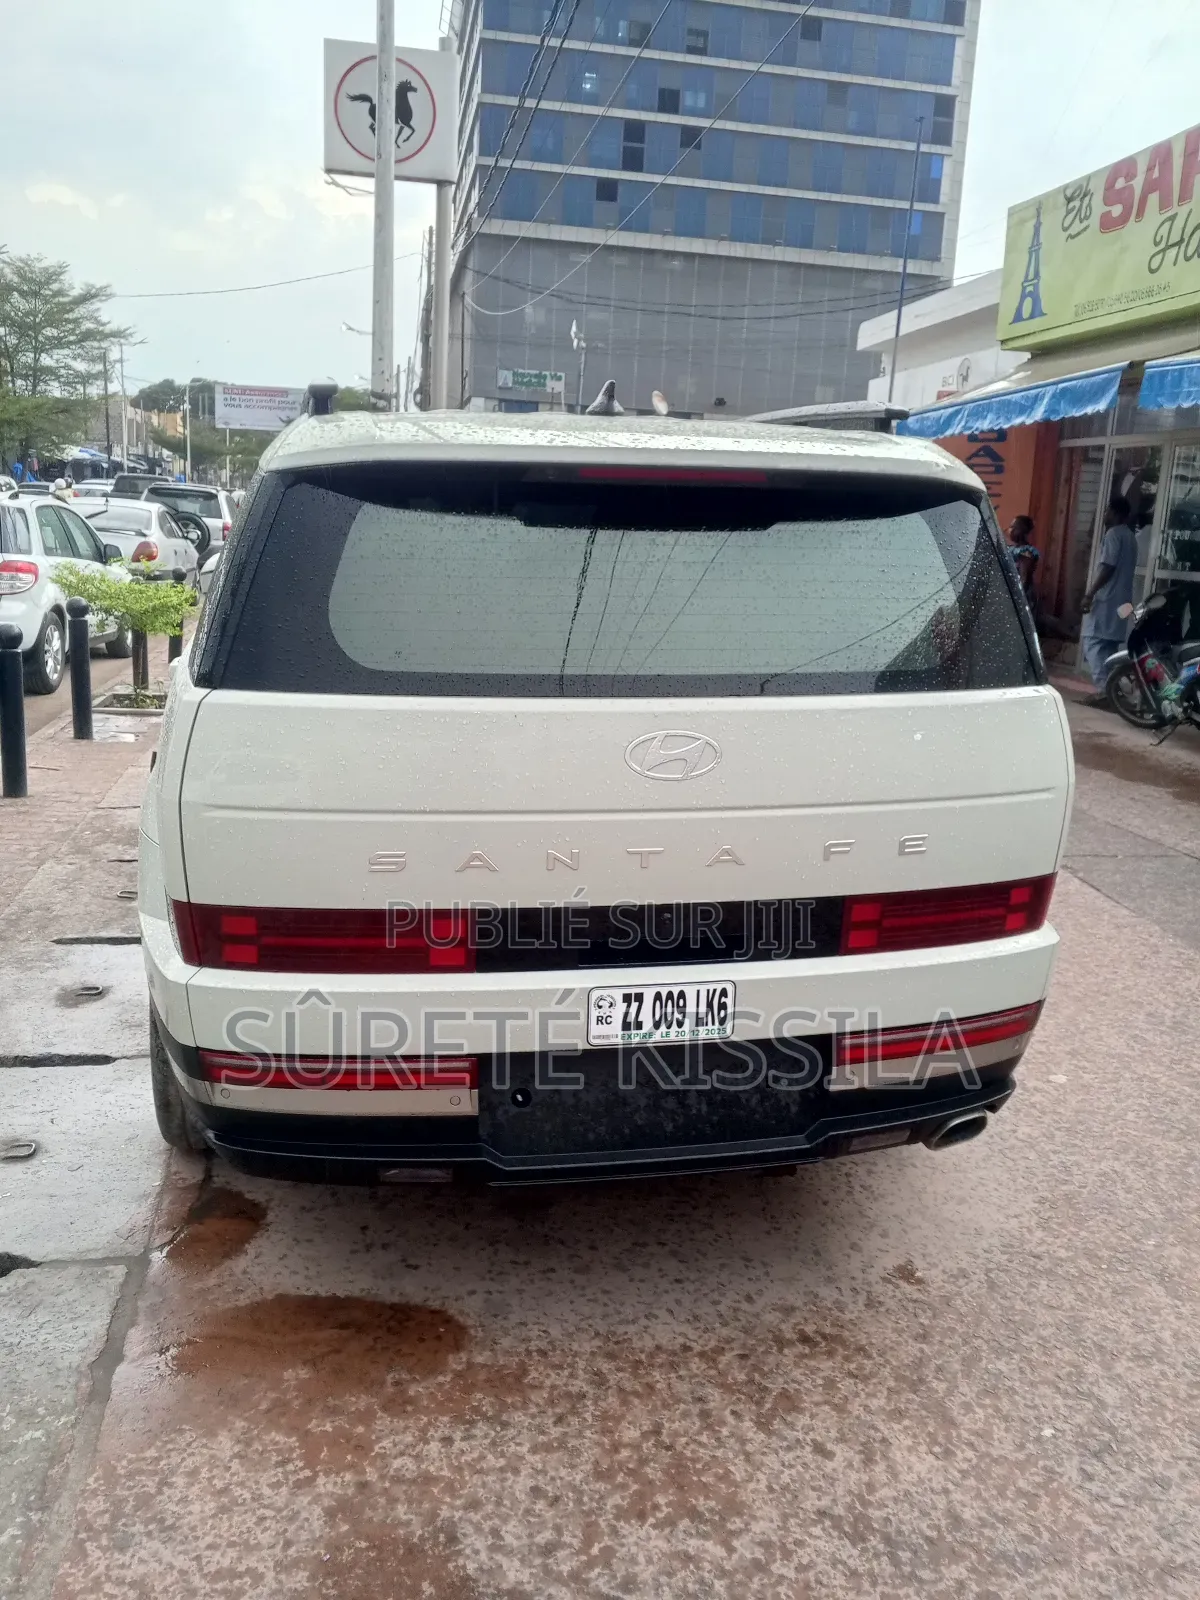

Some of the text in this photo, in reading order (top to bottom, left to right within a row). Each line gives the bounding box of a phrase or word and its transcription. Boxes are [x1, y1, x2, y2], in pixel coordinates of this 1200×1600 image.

[368, 833, 929, 873] SANTA FE
[596, 1014, 613, 1026] RC
[621, 992, 645, 1032] ZZ
[652, 989, 687, 1030] 009
[660, 1030, 671, 1039] LE
[675, 1027, 727, 1038] 20/12/2025
